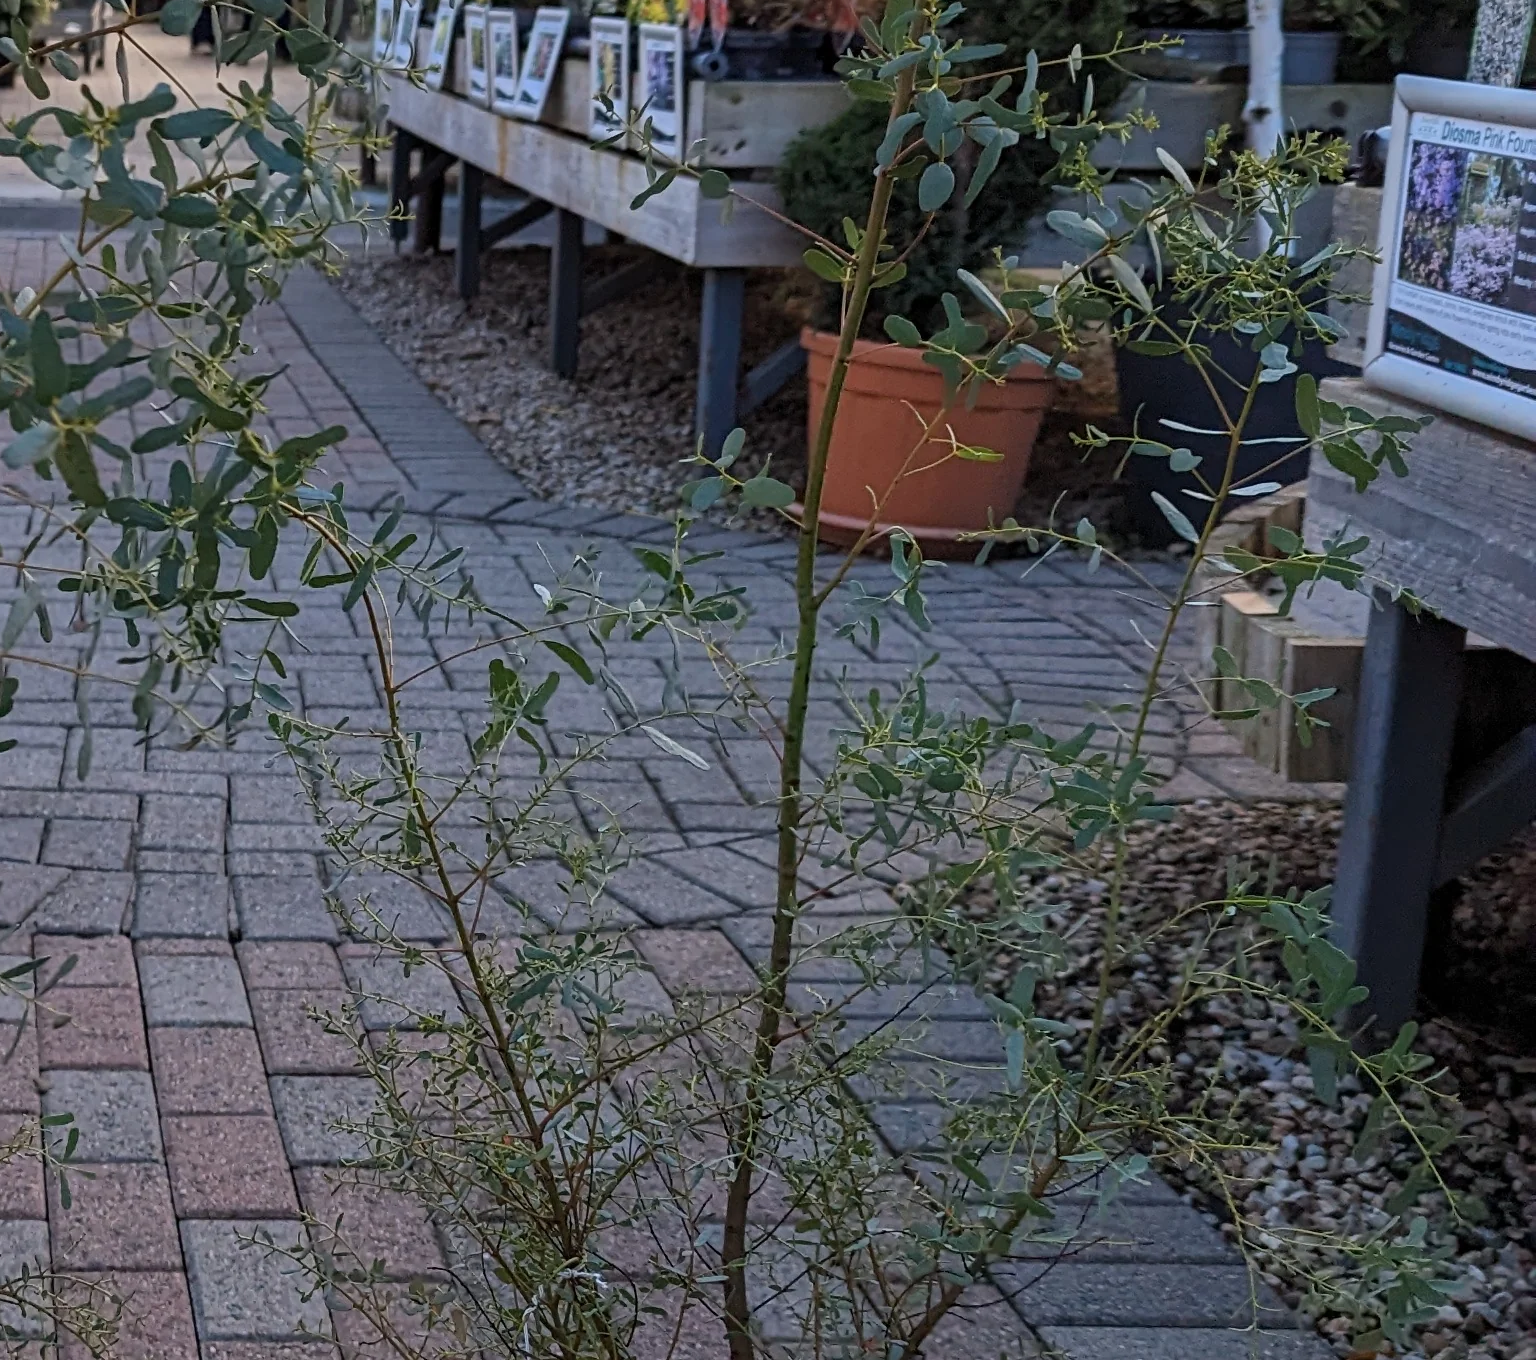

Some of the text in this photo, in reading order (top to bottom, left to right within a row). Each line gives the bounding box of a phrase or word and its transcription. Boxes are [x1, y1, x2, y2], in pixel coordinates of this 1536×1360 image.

[1442, 121, 1481, 146] Diosma
[1482, 126, 1505, 148] Pink
[1506, 130, 1536, 154] Foun
